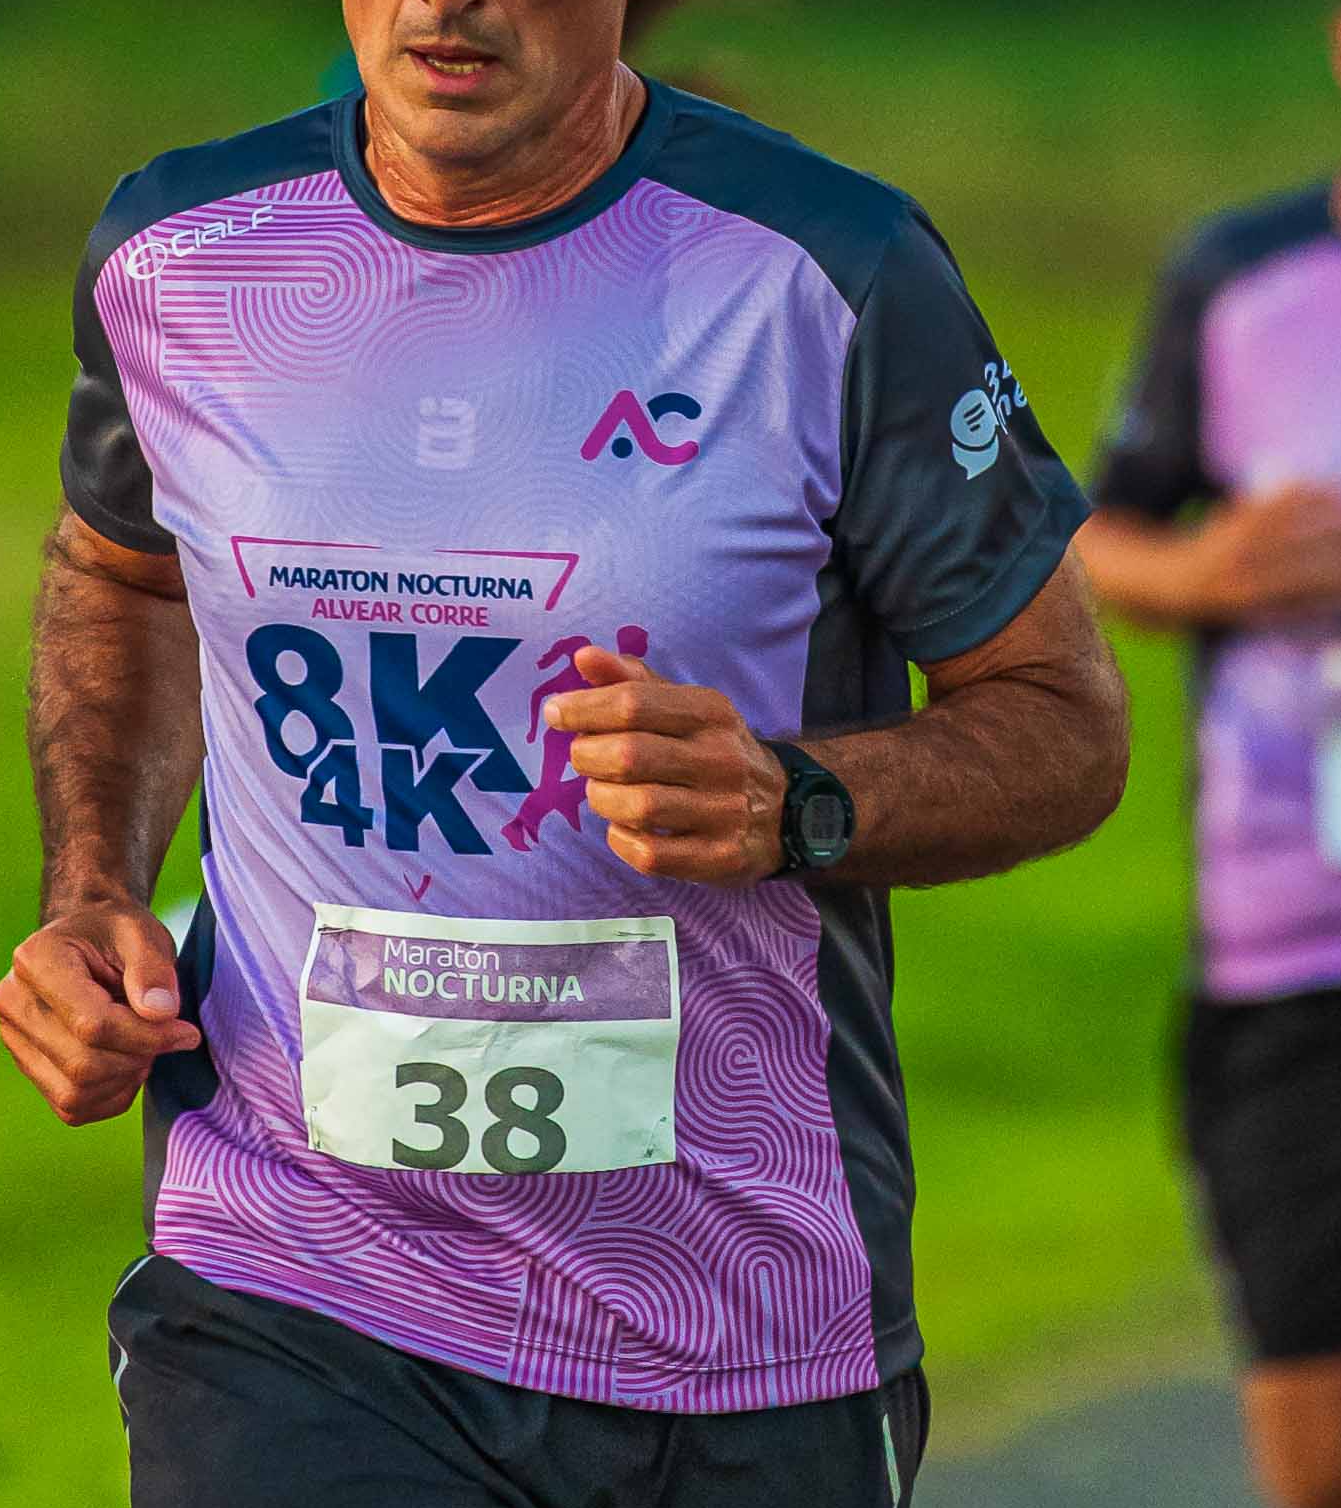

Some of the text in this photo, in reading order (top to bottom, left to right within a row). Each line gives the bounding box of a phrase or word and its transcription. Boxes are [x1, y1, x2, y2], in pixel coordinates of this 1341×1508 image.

[269, 565, 534, 601] MARATON NOCTURNA
[311, 598, 491, 628] ALVEAR CORRE
[245, 622, 536, 794] 8K
[299, 744, 495, 856] 4K
[383, 936, 501, 972] Maratón
[382, 967, 586, 1003] NOCTURNA
[392, 1061, 568, 1176] 38
